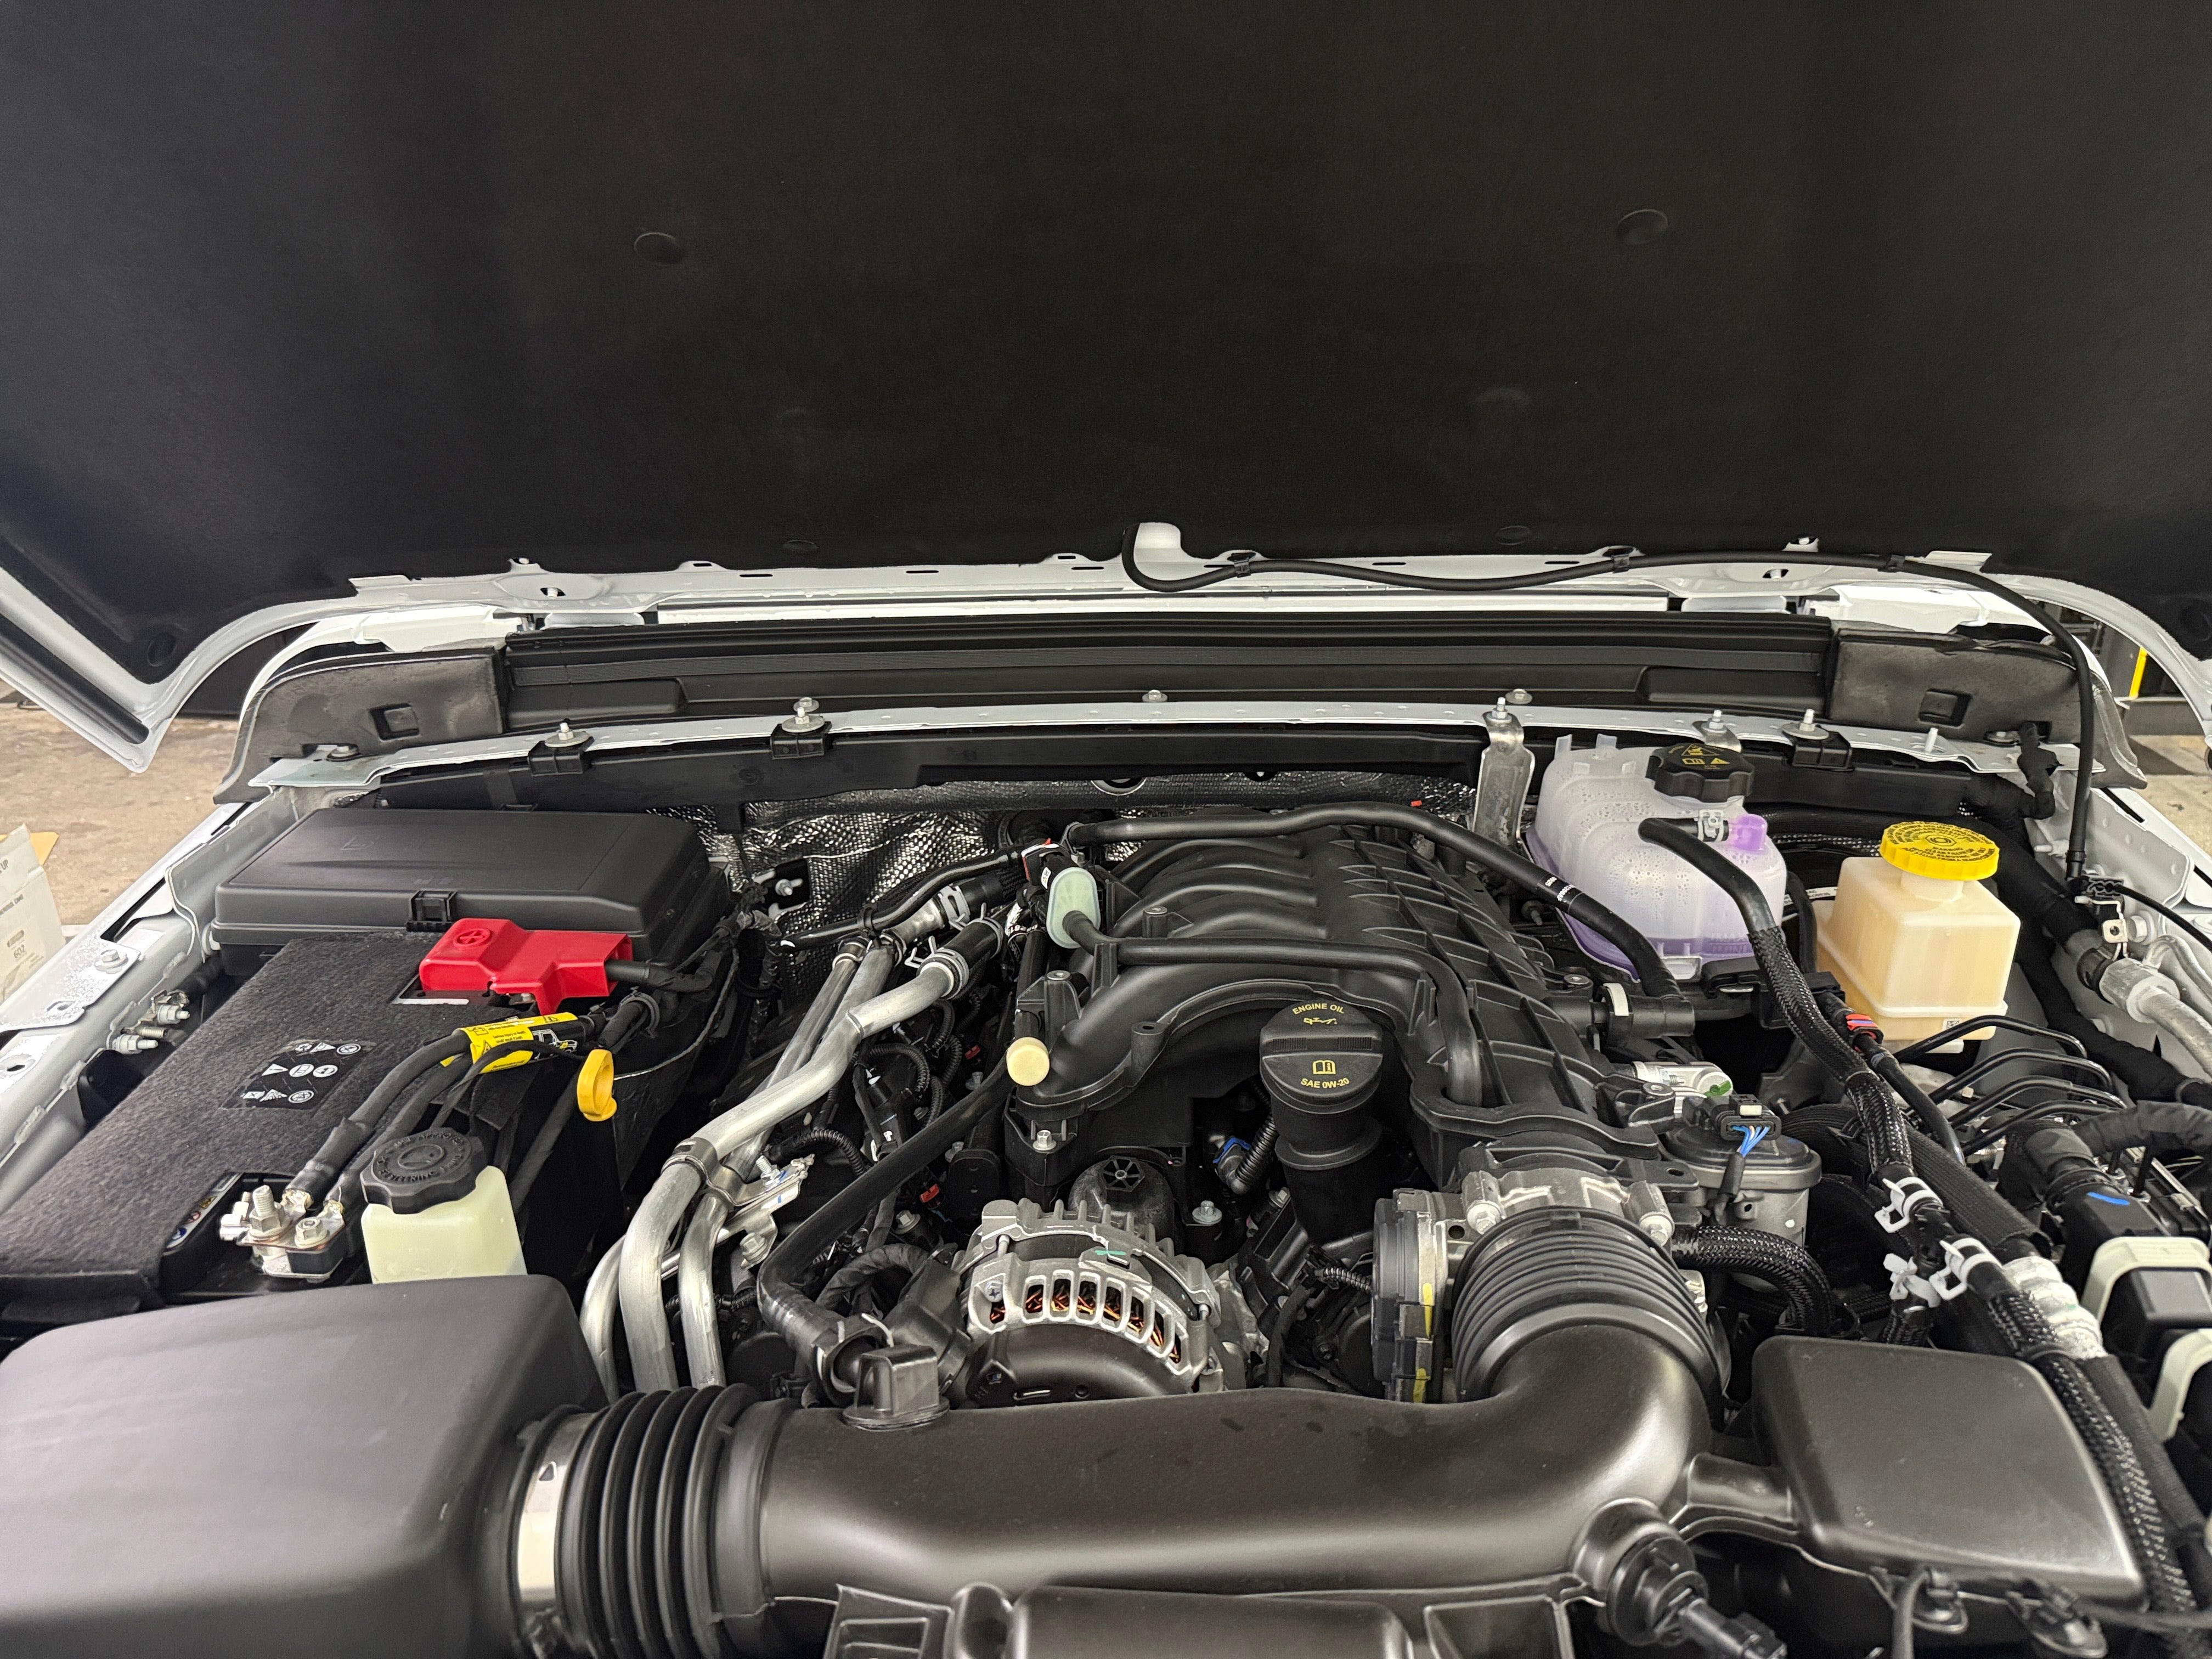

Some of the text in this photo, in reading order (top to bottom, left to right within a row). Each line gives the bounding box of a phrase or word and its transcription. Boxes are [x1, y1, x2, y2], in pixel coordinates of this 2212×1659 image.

[13, 944, 26, 959] 602
[1292, 1003, 1345, 1015] ENGINE OIL
[1300, 1077, 1350, 1089] SAE 0W-20
